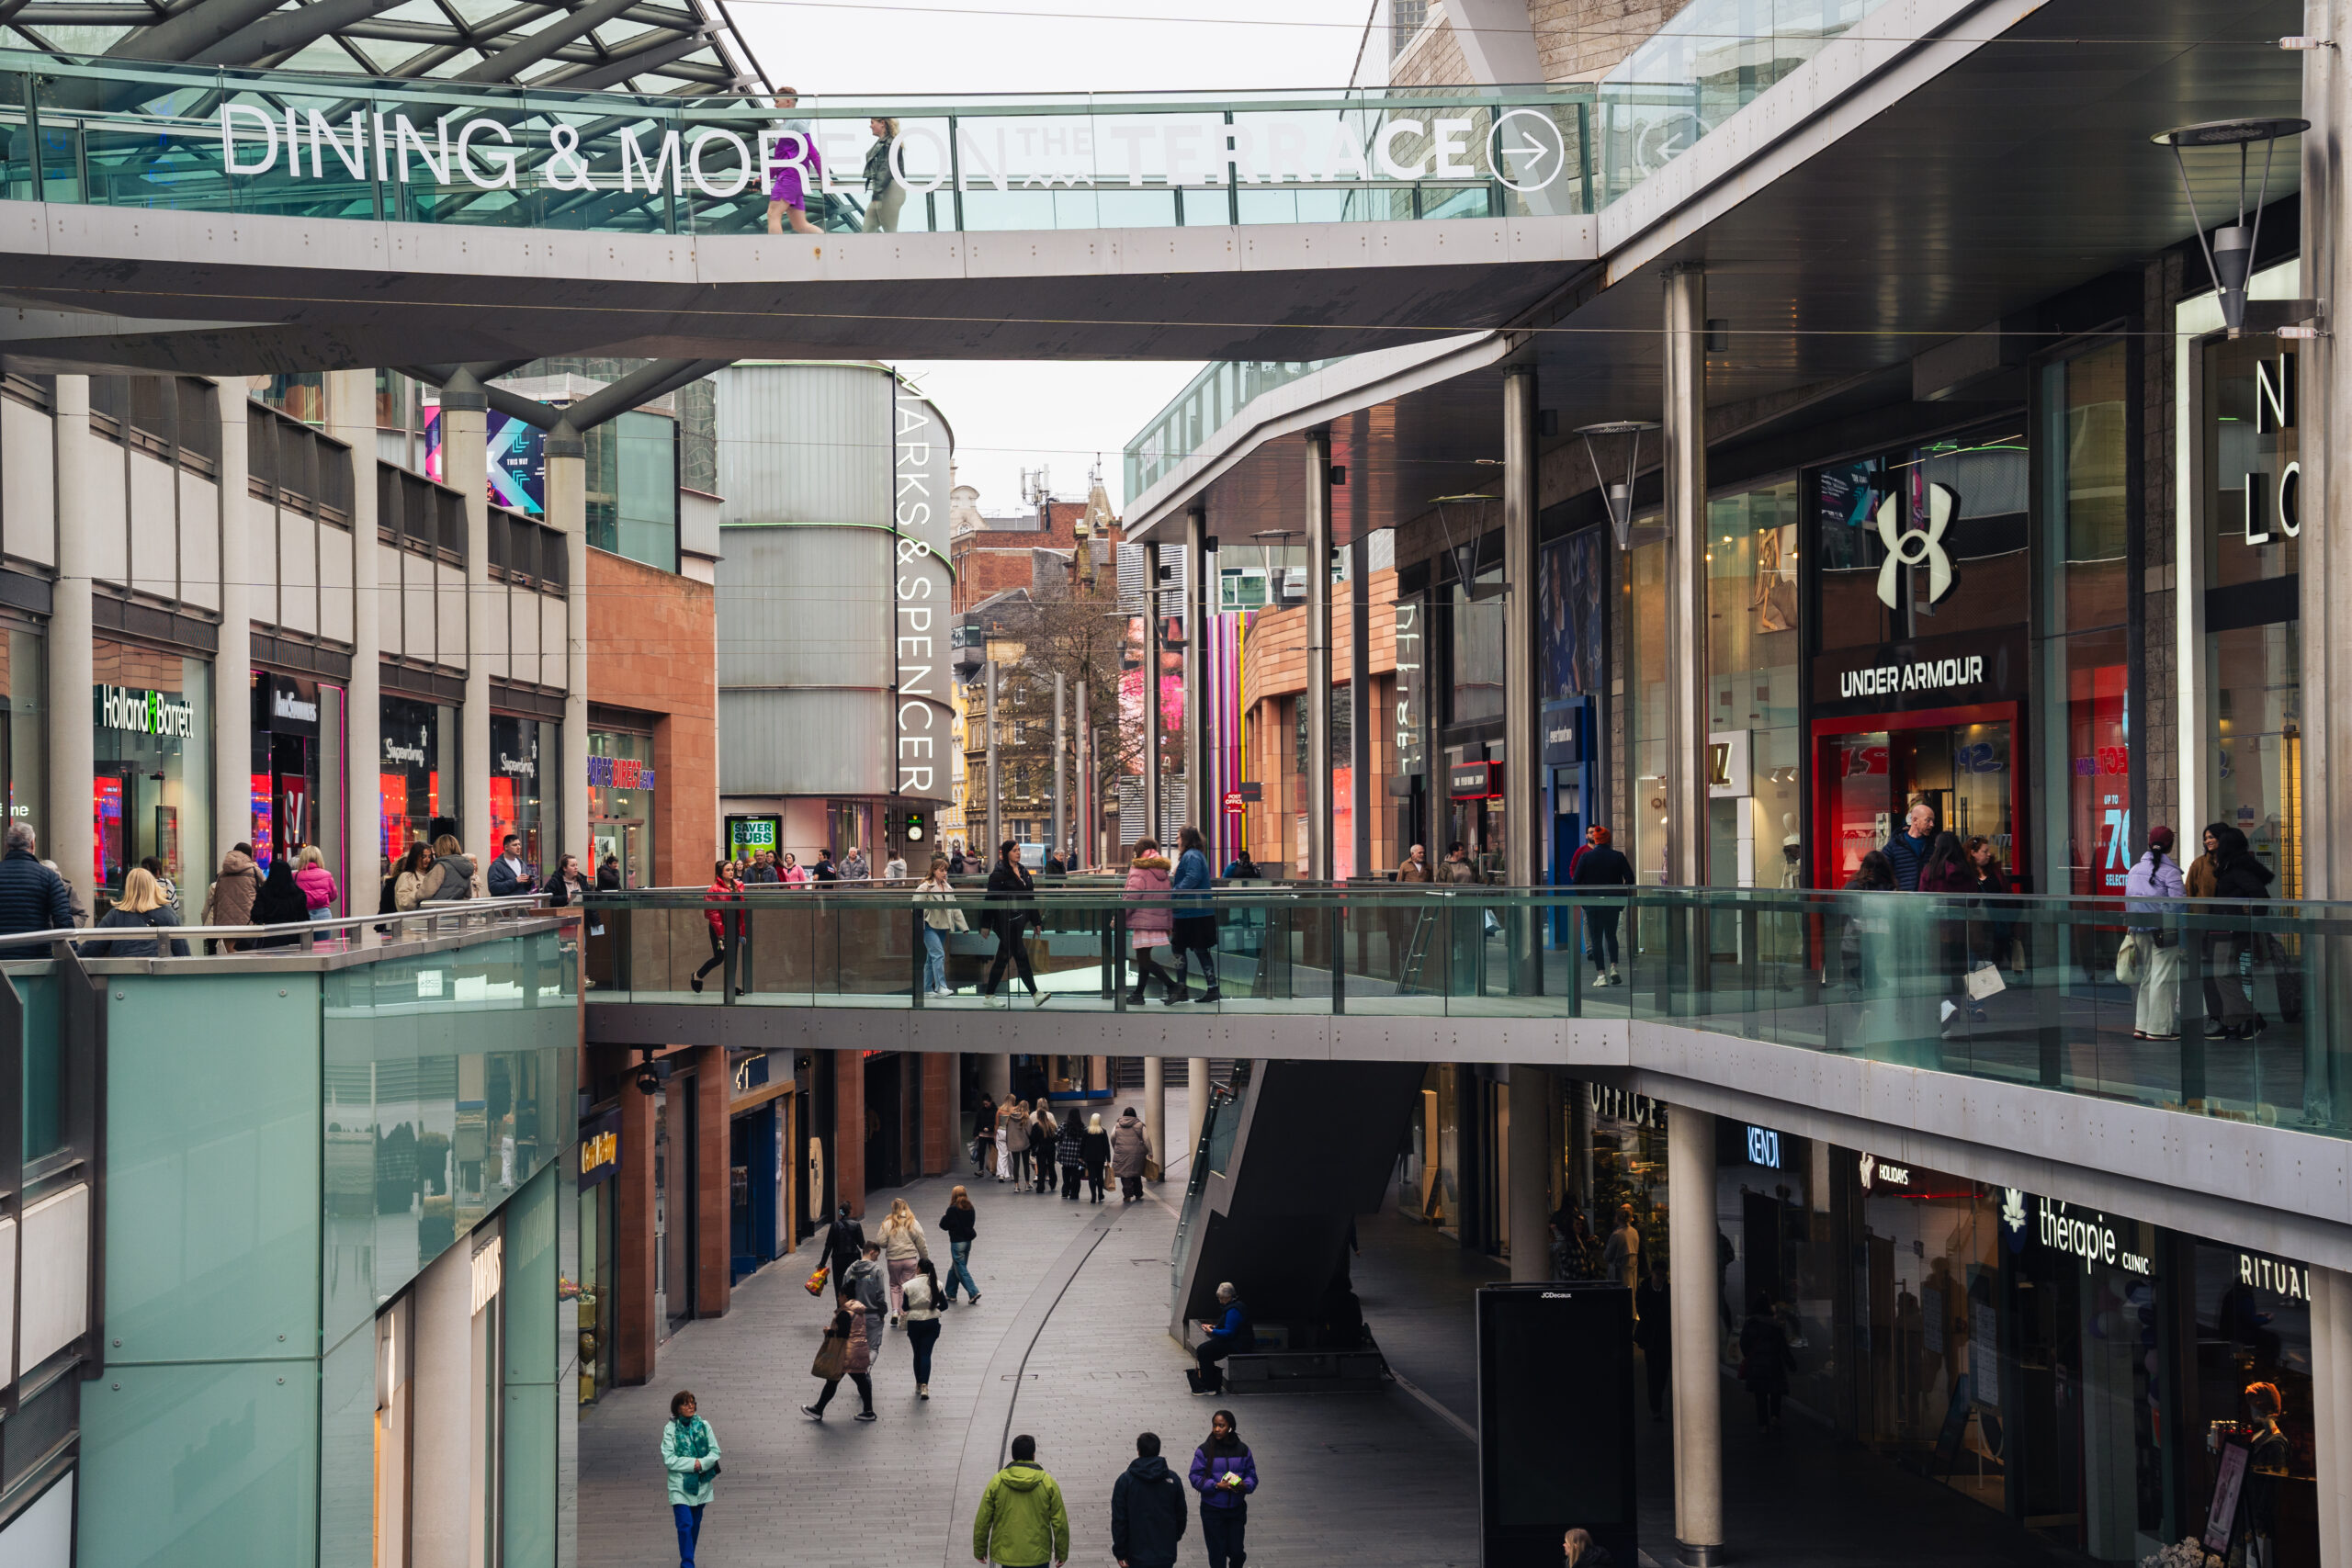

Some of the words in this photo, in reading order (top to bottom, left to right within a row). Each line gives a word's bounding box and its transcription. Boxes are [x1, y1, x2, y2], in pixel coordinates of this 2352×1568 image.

[220, 103, 516, 191] DINING
[546, 123, 597, 192] &
[623, 126, 866, 199] MORE
[888, 126, 1009, 194] ON
[1016, 126, 1092, 156] THE
[1110, 118, 1476, 187] TERRACE
[895, 371, 931, 526] MARKS
[897, 538, 931, 566] &
[897, 575, 934, 794] SPENCER
[1841, 666, 1899, 698] UNDER
[1901, 655, 1983, 692] ARMOUR
[385, 737, 424, 768] Superdrug
[500, 752, 535, 778] Superdrug
[2104, 795, 2111, 806] UP
[2111, 794, 2119, 805] TO
[734, 822, 773, 832] SAVER
[734, 832, 773, 843] SUBS
[1747, 1125, 1780, 1169] KENJI
[1879, 1163, 1909, 1186] HOLIDAYS
[2039, 1196, 2116, 1275] thérapie
[2122, 1251, 2150, 1276] CLINIC
